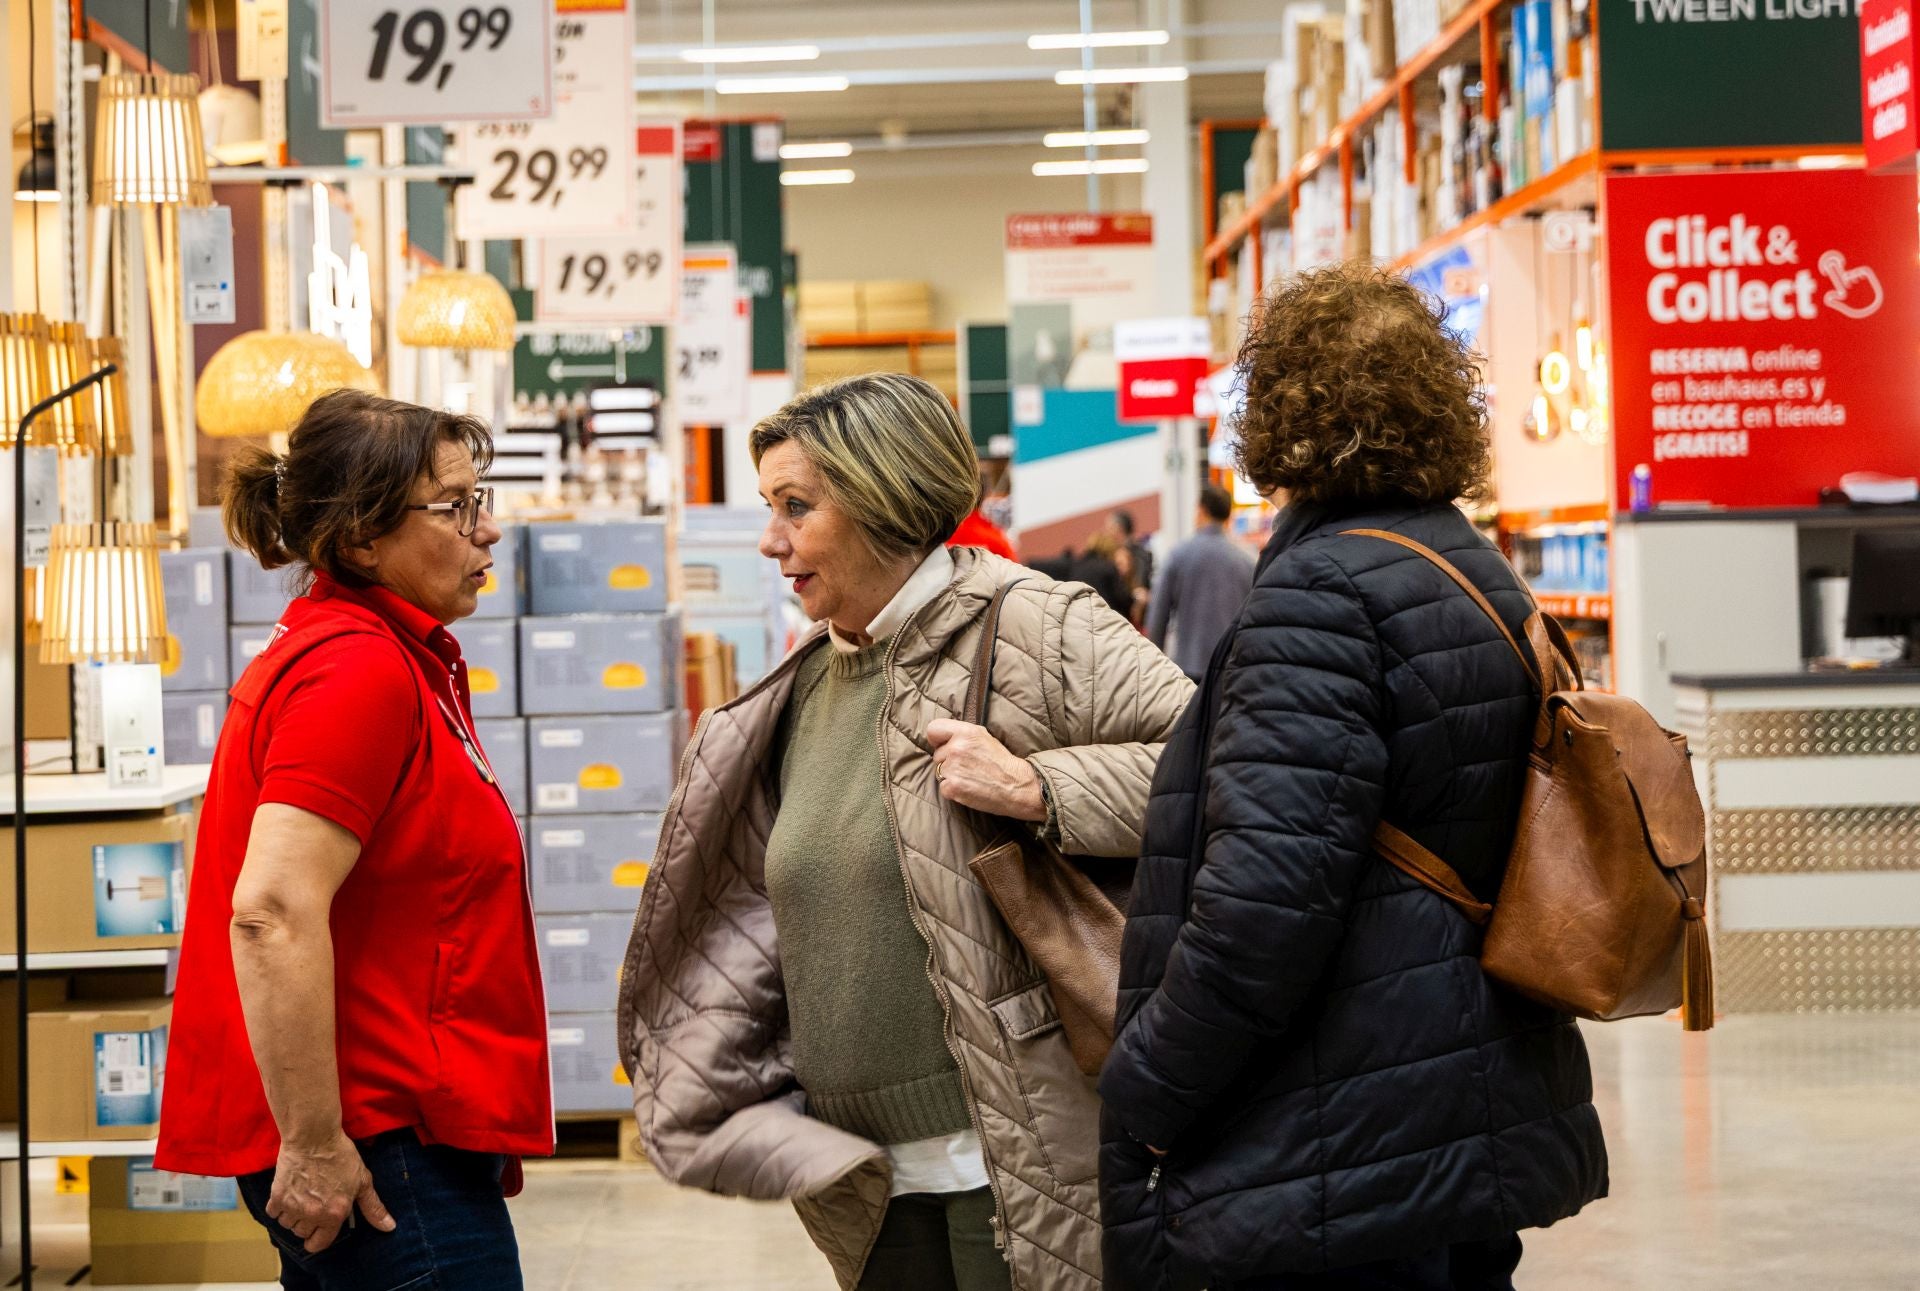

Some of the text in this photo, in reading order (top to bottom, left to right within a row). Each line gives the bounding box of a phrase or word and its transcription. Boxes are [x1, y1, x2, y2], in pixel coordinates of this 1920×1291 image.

[1627, 0, 1756, 23] TWEEN
[367, 8, 511, 90] 19,99
[489, 148, 608, 208] 29,99
[1646, 214, 1797, 268] Click &
[558, 252, 662, 298] 19,99
[1647, 269, 1817, 323] Collect
[1651, 344, 1822, 374] RESERVA online
[1651, 375, 1826, 403] en bauhaus.es y
[1652, 400, 1846, 430] RECOGE en tienda
[1653, 430, 1749, 462] ¡GRATIS!
